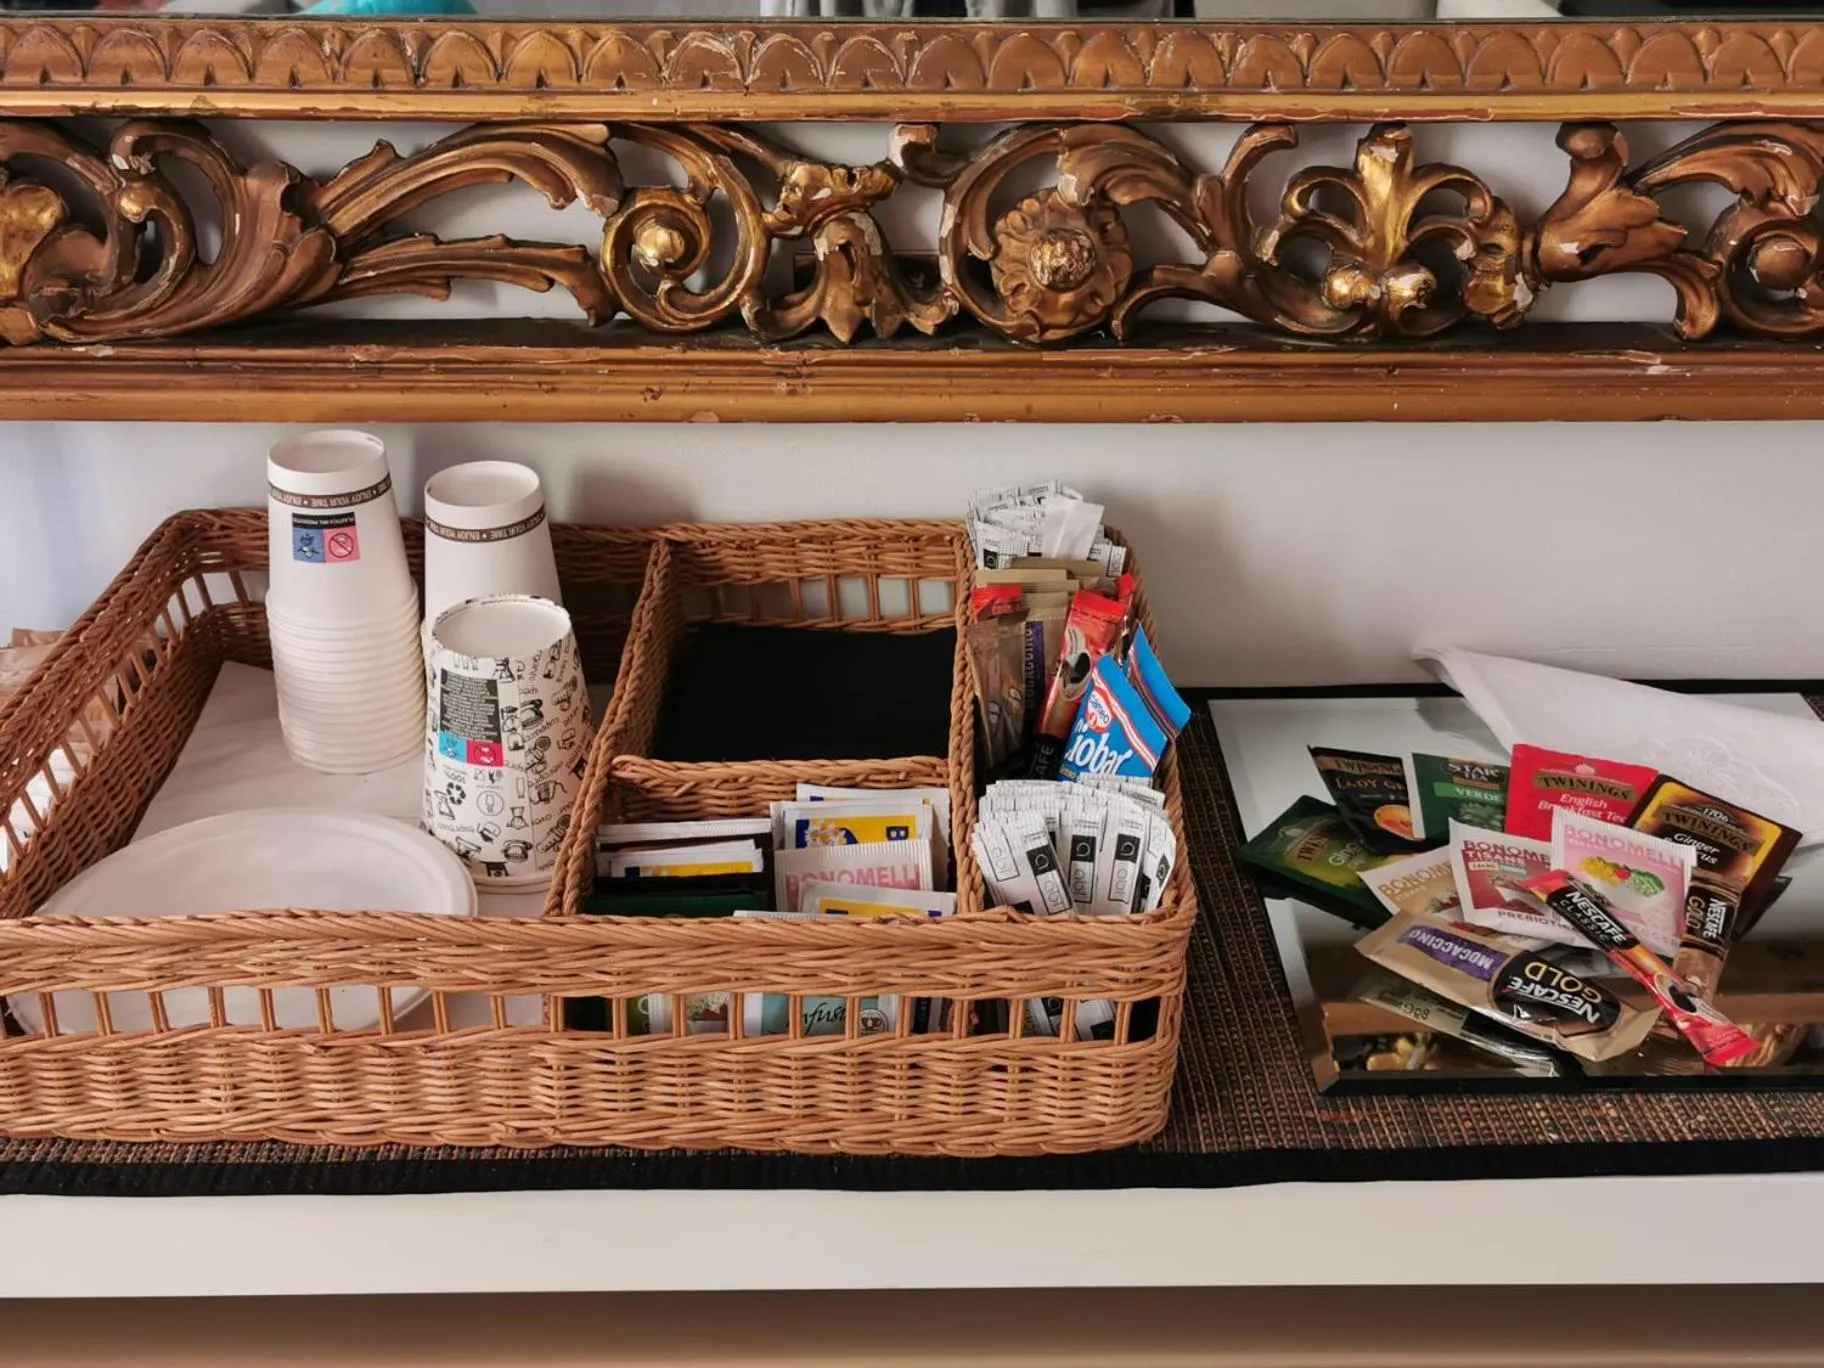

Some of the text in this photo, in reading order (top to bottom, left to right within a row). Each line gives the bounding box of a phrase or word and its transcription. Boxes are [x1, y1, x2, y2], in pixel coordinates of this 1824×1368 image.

[311, 498, 328, 507] TIME
[330, 496, 350, 506] YOUR
[457, 530, 480, 541] ENJOY
[489, 527, 507, 539] TIME
[1537, 774, 1634, 799] TWININGS
[1560, 793, 1608, 809] English
[1703, 808, 1729, 822] 1706
[1662, 812, 1755, 852] TWININGS
[1673, 833, 1720, 853] Ginger
[1463, 840, 1551, 867] BONOME
[1560, 899, 1610, 942] CLASSIC
[1409, 929, 1495, 970] MOCACCINO
[1524, 962, 1602, 1004] GOLD
